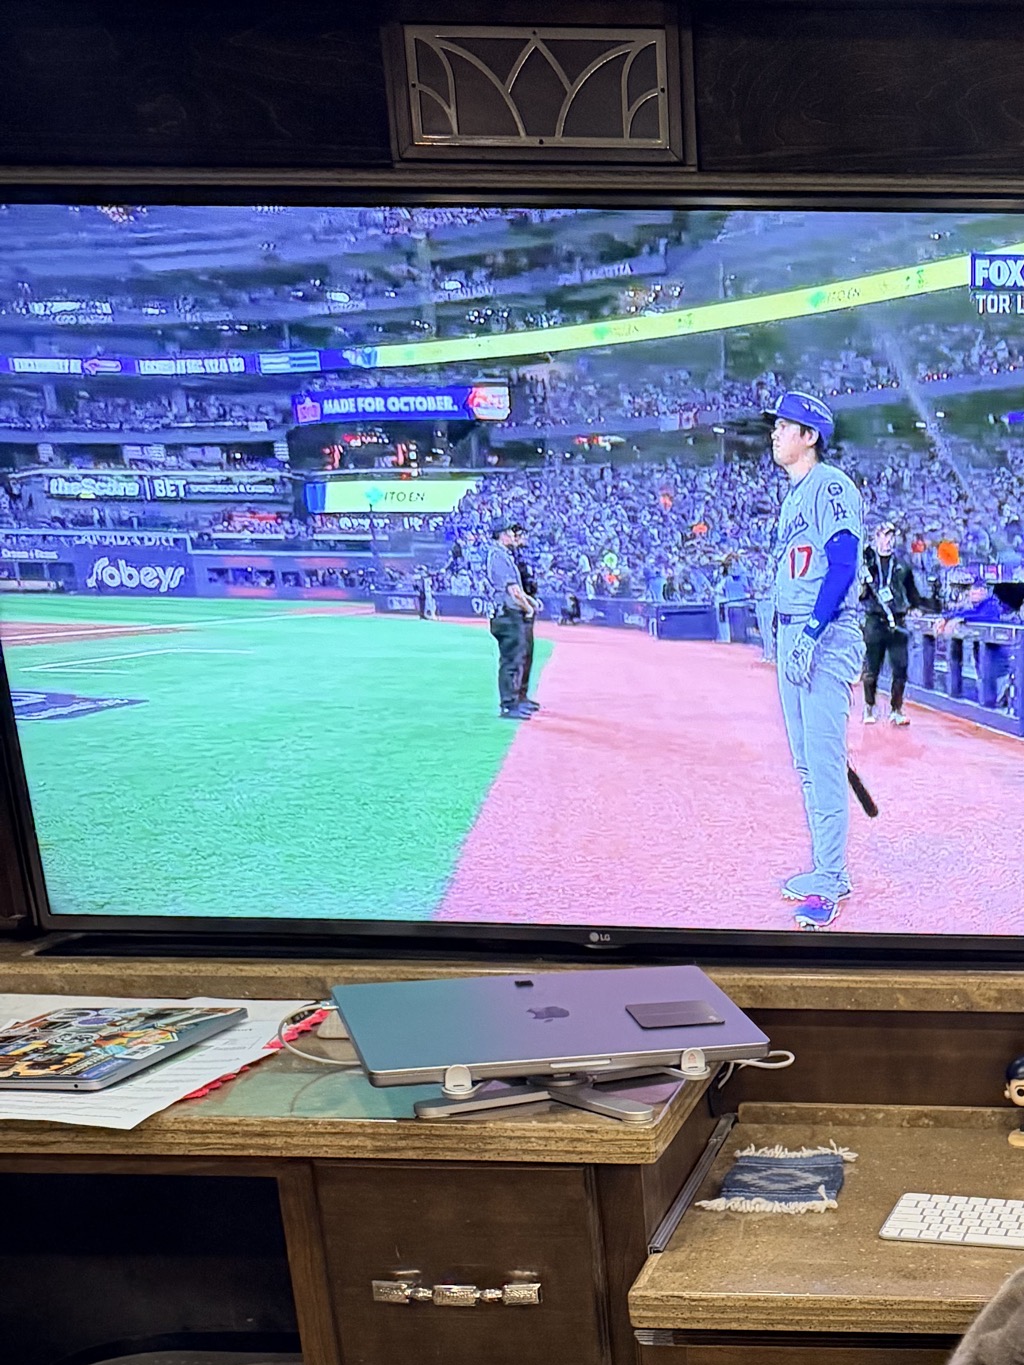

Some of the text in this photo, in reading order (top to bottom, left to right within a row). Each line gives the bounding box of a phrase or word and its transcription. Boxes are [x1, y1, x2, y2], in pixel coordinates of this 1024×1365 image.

[976, 295, 1011, 314] TOR
[323, 397, 356, 414] MADE
[357, 397, 386, 413] FOR
[153, 478, 187, 498] BET
[789, 545, 813, 580] 17
